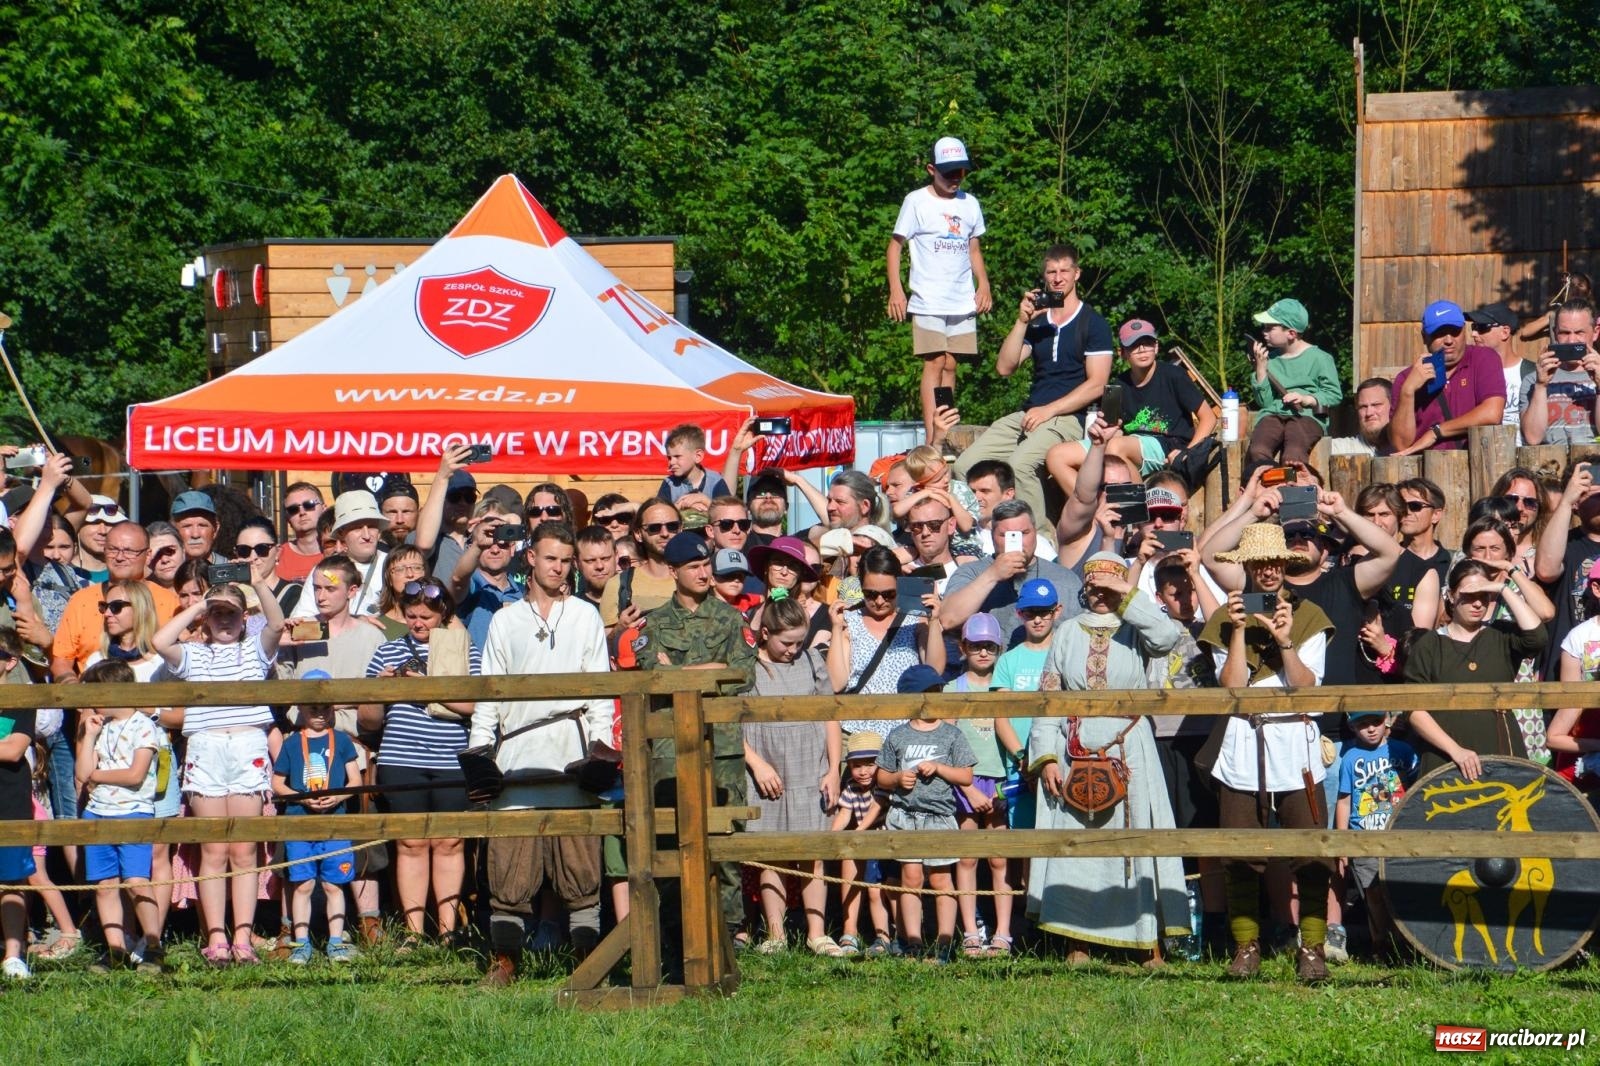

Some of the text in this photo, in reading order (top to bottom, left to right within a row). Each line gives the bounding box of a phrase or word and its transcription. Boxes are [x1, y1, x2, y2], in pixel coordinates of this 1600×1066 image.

[443, 282, 525, 298] ZESPÓŁ SZKÓŁ
[443, 298, 516, 321] ZDZ
[334, 386, 577, 405] www.zdz.pl
[144, 425, 274, 453] LICEUM
[533, 430, 570, 456] W
[578, 429, 728, 456] RYBNU
[905, 744, 939, 759] NIKE
